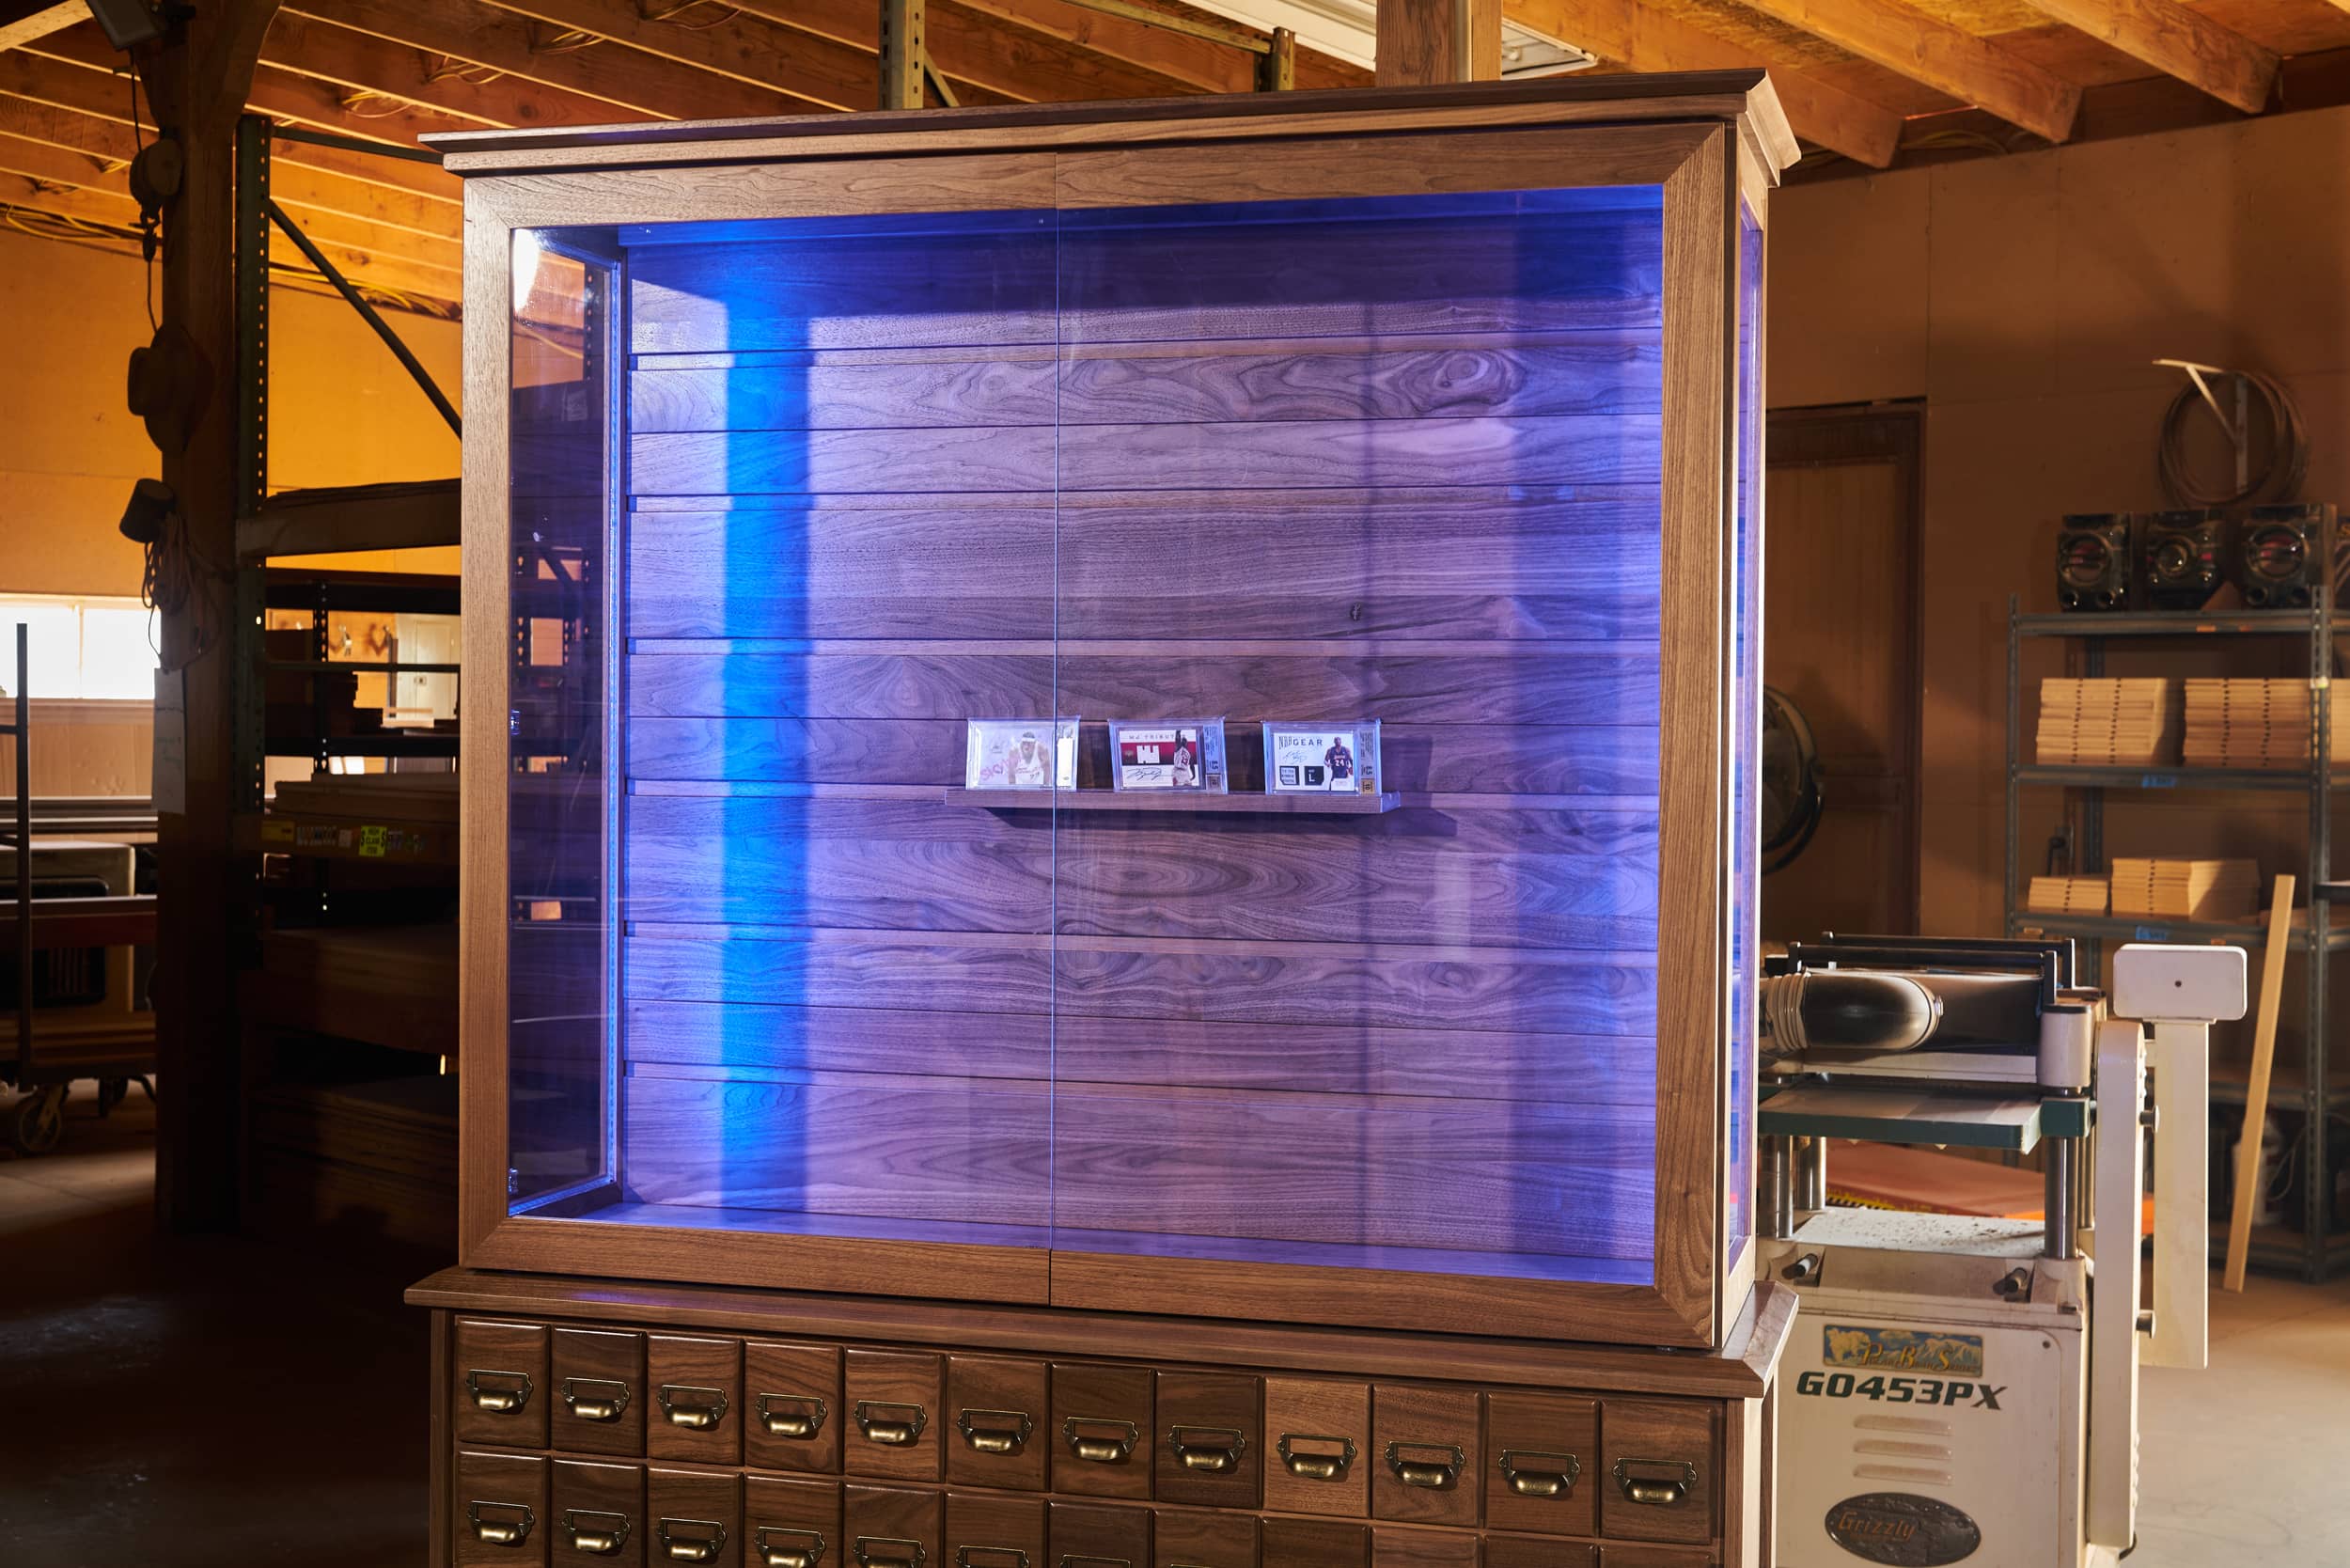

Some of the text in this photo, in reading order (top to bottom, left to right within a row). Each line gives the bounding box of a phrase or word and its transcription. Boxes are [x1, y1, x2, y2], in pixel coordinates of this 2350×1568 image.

[1292, 738, 1324, 746] GEAR
[1334, 759, 1345, 767] 24
[1836, 1511, 1917, 1542] Grizzly
